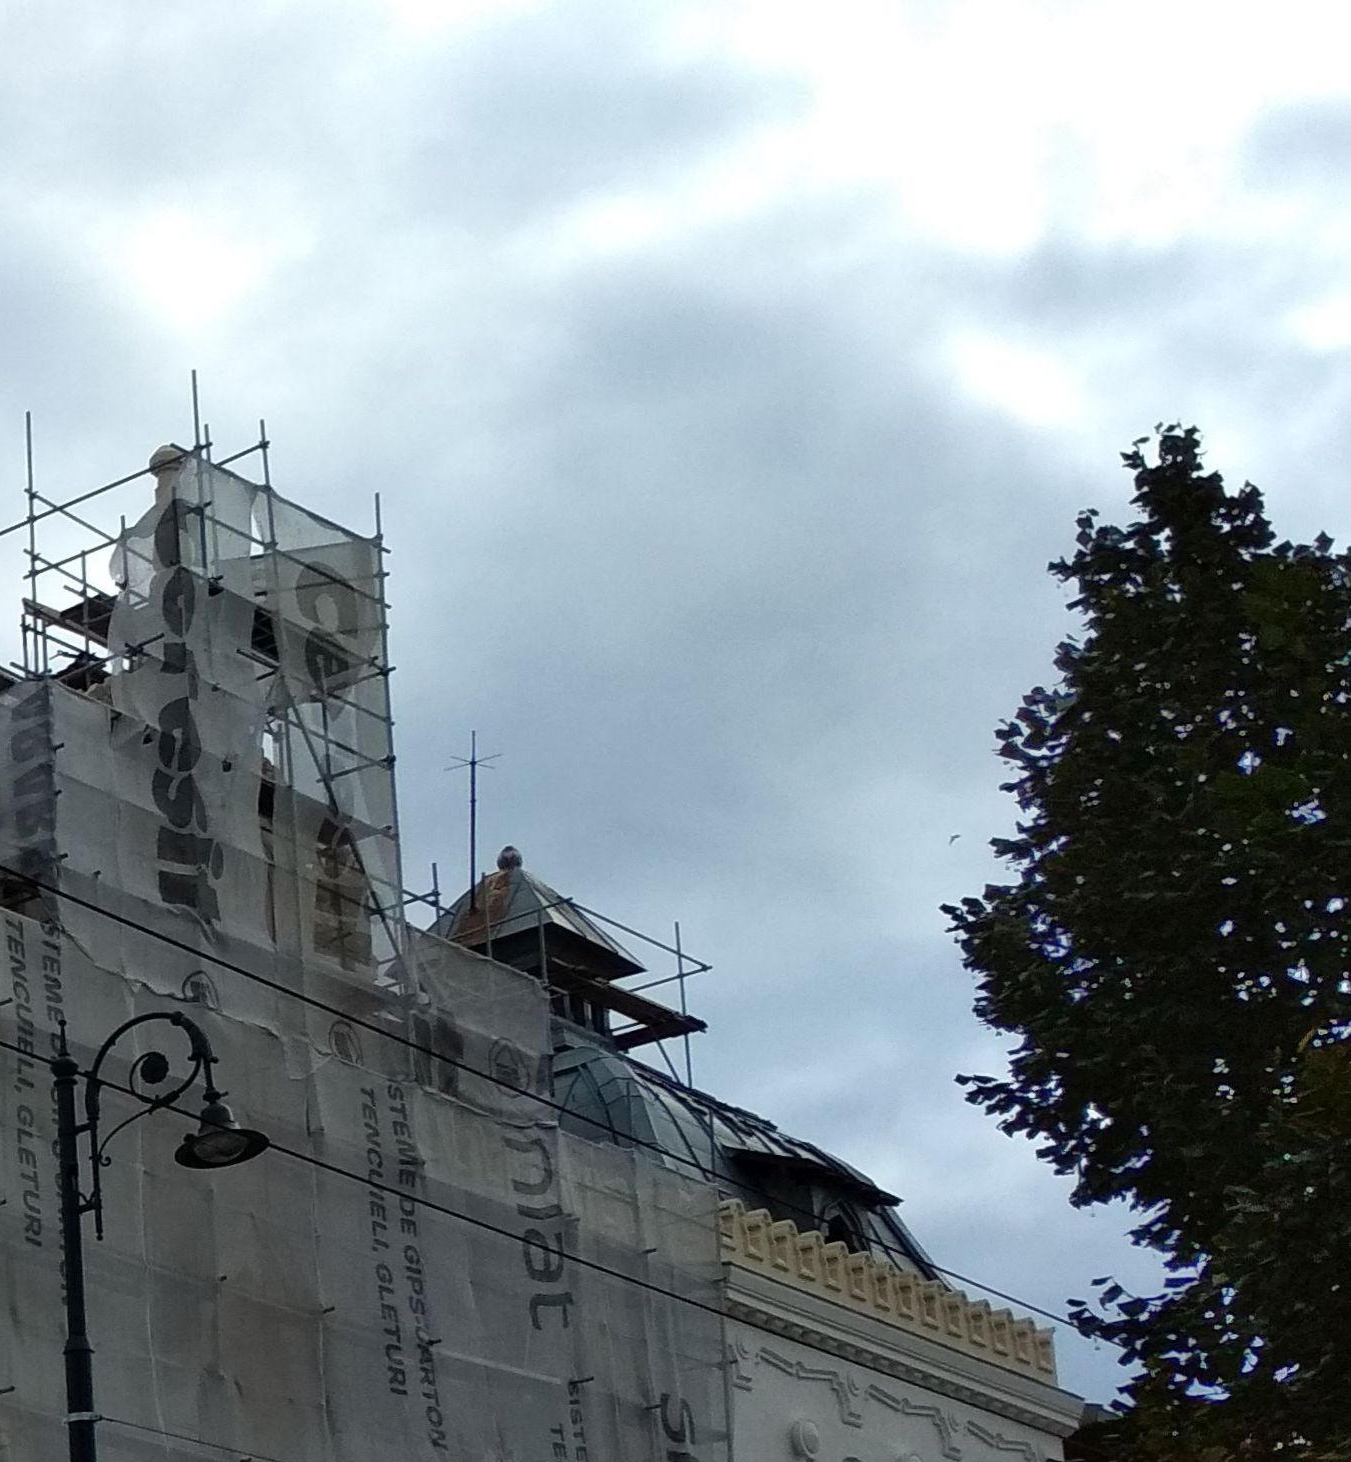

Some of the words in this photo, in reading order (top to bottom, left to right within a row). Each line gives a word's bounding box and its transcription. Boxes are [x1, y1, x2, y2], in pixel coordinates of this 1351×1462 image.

[5, 915, 35, 1092] TENCUIELI,
[39, 919, 66, 1023] STEME
[16, 1103, 44, 1248] GLETURI
[387, 1083, 418, 1188] STEME
[398, 1201, 418, 1237] DE
[502, 1133, 575, 1331] niat
[375, 1263, 409, 1397] GLETURI
